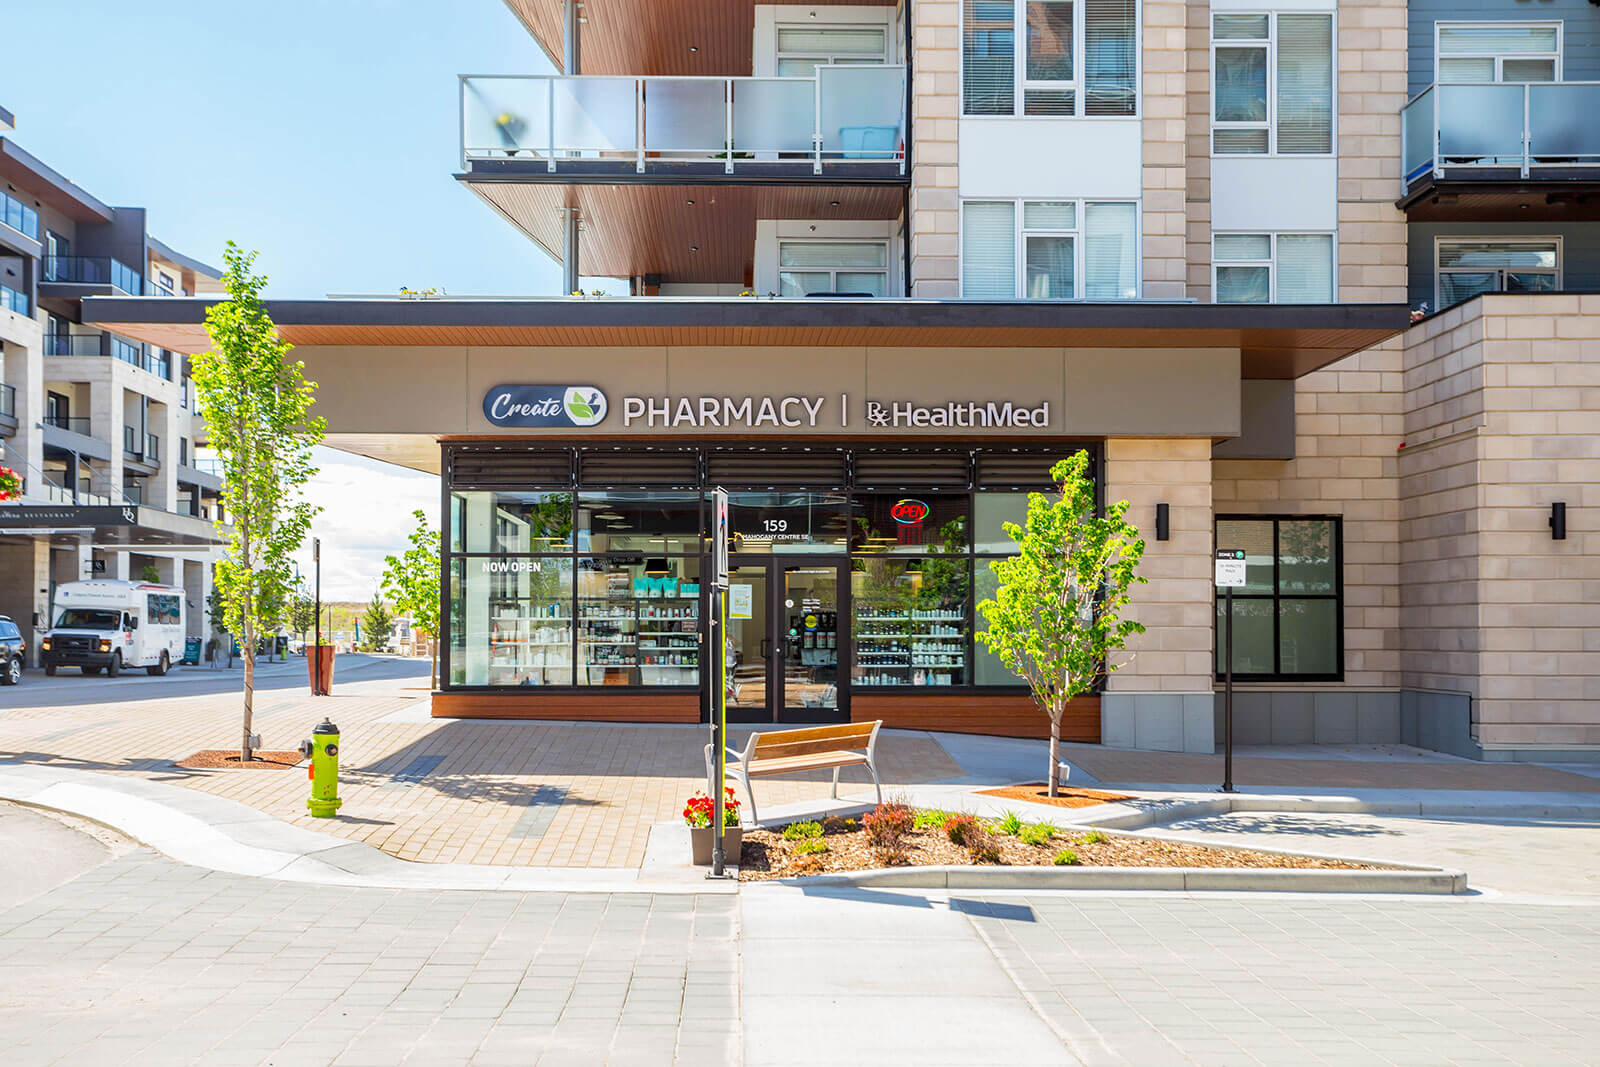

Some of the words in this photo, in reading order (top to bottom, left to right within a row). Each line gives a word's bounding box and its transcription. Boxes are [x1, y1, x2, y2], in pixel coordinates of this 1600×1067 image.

[491, 393, 563, 420] Create
[623, 397, 825, 427] PHARMACY
[891, 504, 926, 518] OPEN
[763, 519, 788, 532] 159
[482, 562, 508, 573] NOW
[511, 562, 541, 573] OPEN
